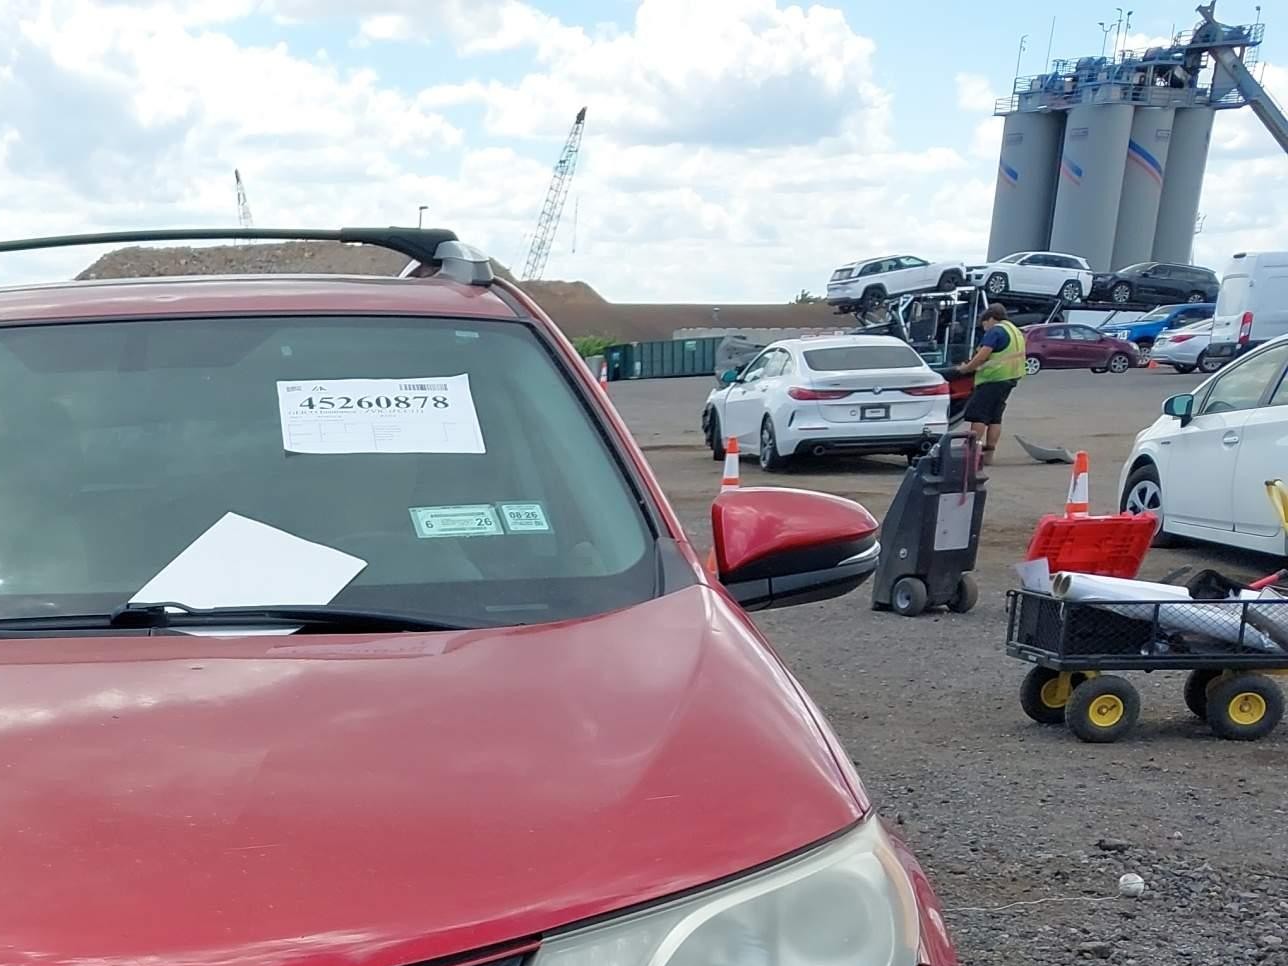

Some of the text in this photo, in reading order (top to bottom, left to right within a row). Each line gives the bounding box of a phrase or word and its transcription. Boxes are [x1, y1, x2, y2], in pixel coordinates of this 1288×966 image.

[299, 395, 450, 410] 45260878
[425, 520, 434, 529] 6
[475, 517, 493, 527] 26
